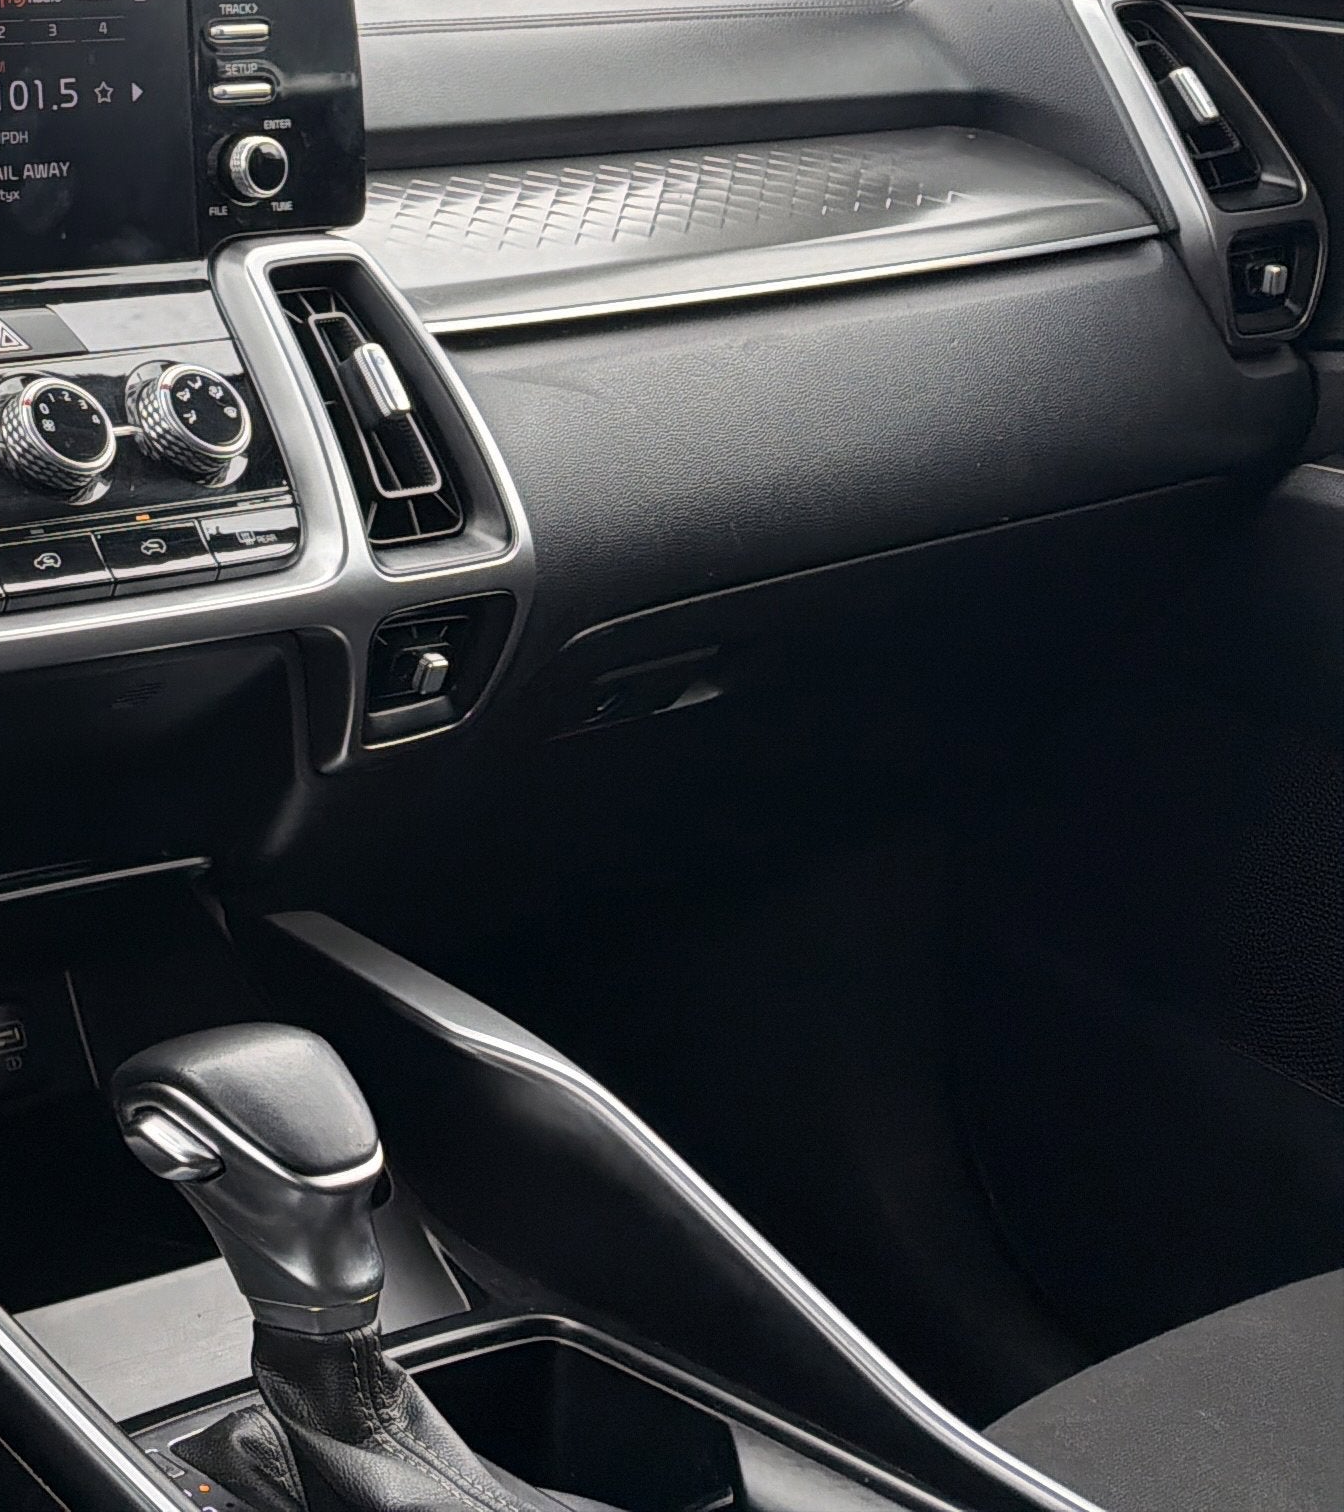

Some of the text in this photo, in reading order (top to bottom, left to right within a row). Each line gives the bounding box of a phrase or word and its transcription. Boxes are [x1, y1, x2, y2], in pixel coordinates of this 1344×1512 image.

[48, 23, 58, 37] 3
[98, 21, 108, 35] 4
[225, 62, 258, 75] SETUP
[23, 161, 71, 179] AWAY
[208, 205, 229, 217] FILE
[270, 200, 293, 212] TUNE
[38, 402, 50, 415] 0
[61, 390, 72, 402] 2
[77, 399, 89, 410] 3
